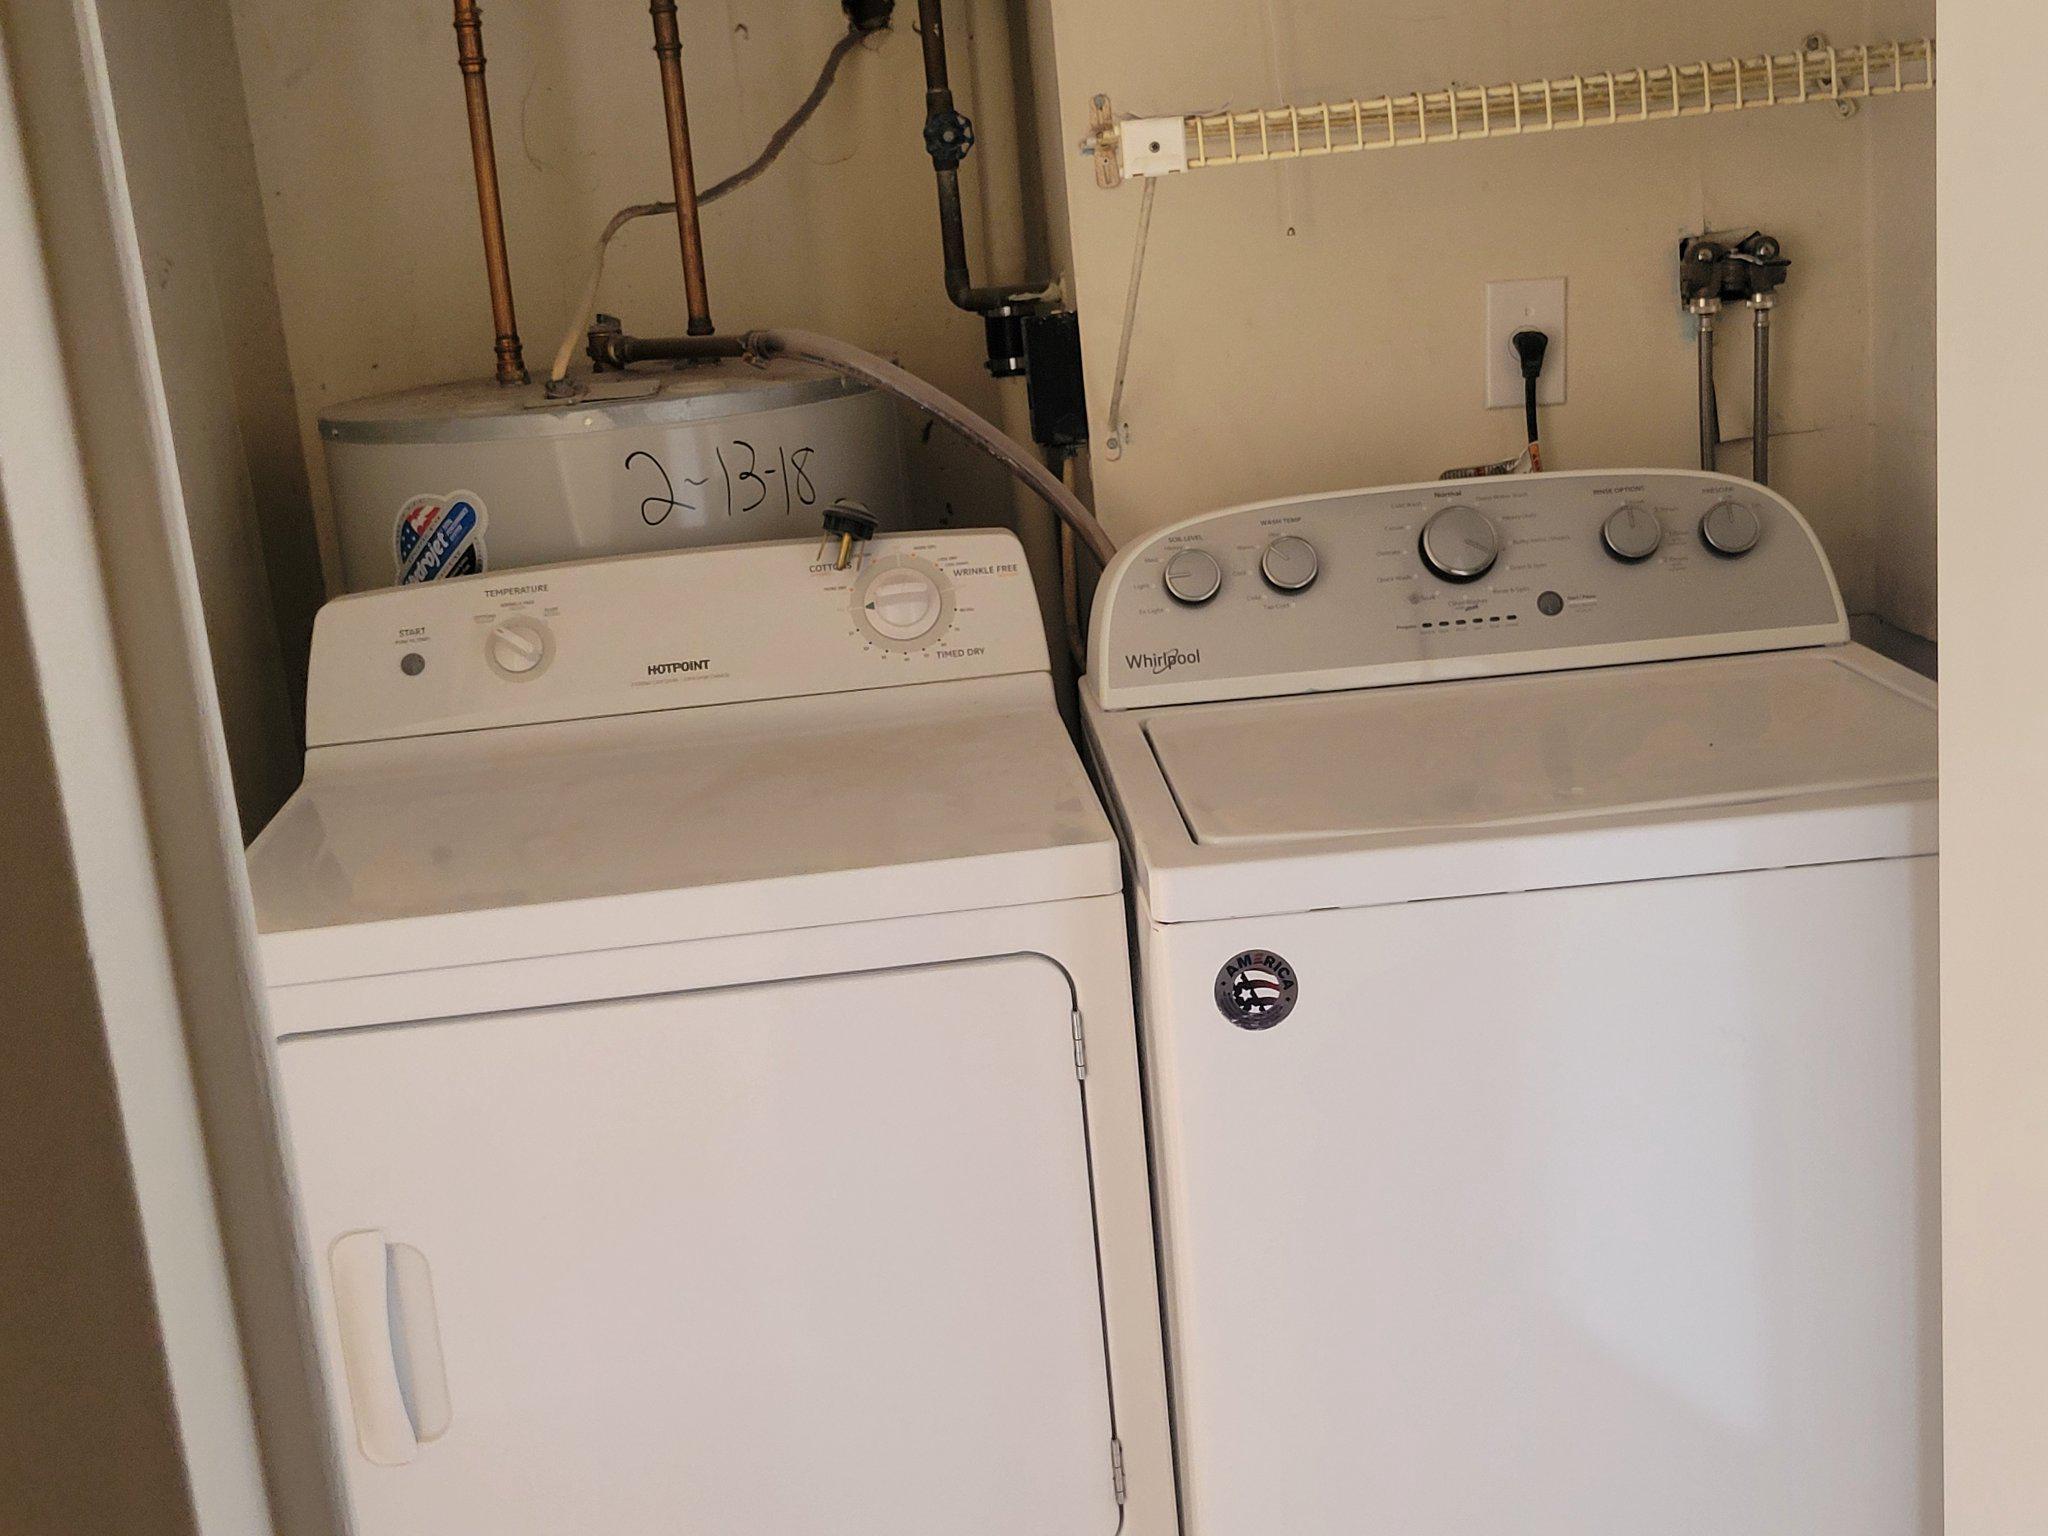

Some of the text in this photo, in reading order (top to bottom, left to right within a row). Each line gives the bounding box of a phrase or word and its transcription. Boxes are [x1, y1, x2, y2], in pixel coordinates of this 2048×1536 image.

[624, 440, 817, 526] 2-13-18
[809, 561, 853, 573] COTTOS
[953, 565, 994, 577] WRINKLE
[996, 563, 1018, 573] FREE
[484, 584, 549, 598] TEMPERATURE
[398, 626, 427, 638] START
[936, 649, 965, 660] TIMED
[966, 647, 985, 657] DRY
[647, 659, 711, 675] HOTPOINT
[1125, 649, 1201, 675] Whirlpool
[1226, 954, 1294, 991] AMERICA
